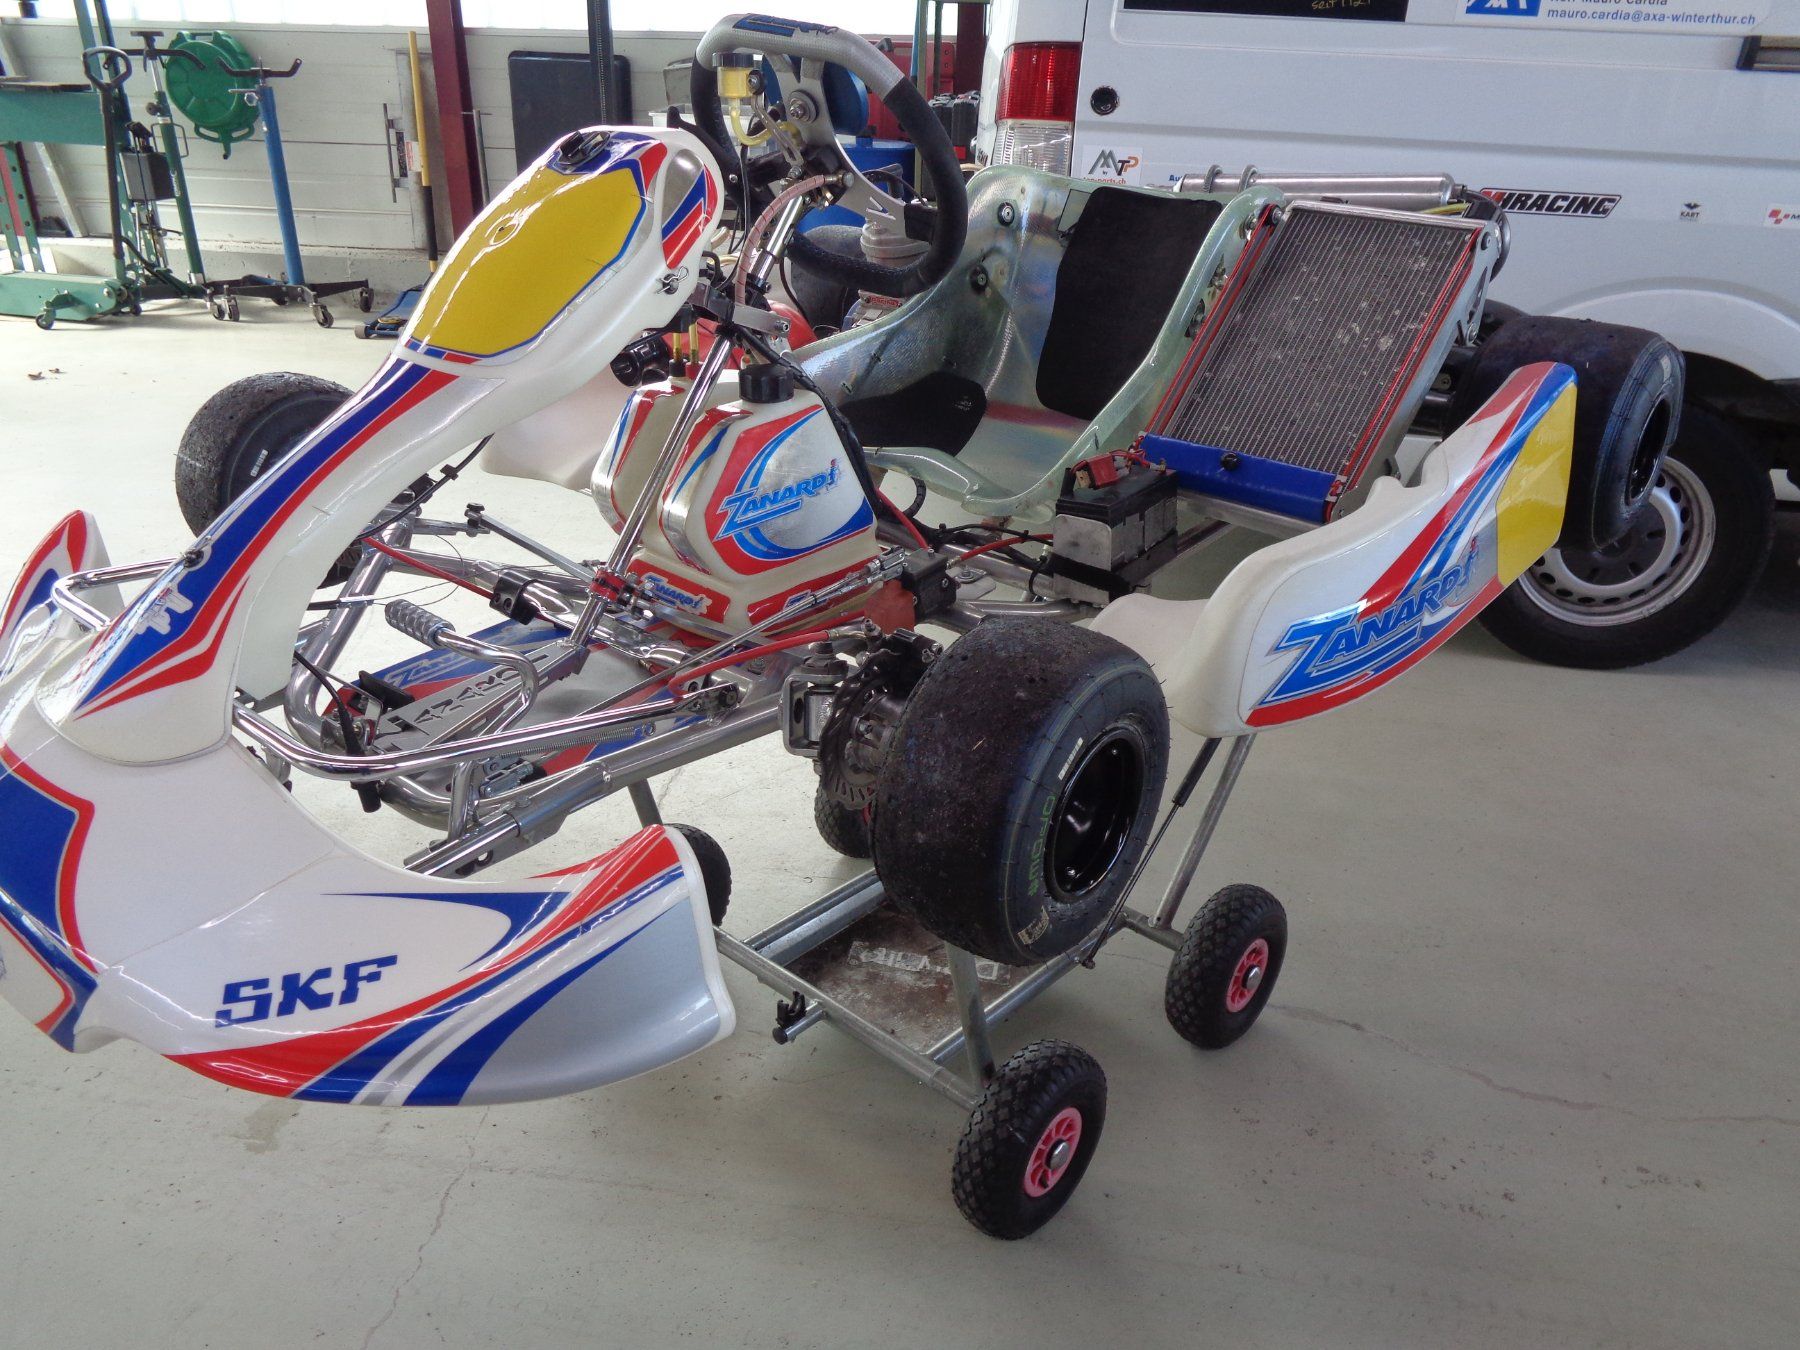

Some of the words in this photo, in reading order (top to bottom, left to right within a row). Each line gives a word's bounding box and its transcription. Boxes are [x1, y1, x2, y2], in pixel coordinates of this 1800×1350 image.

[1547, 8, 1756, 25] mauro.cardia@axa-winterthur.ch
[1249, 535, 1477, 711] ZANARDI
[215, 954, 398, 1029] SKF
